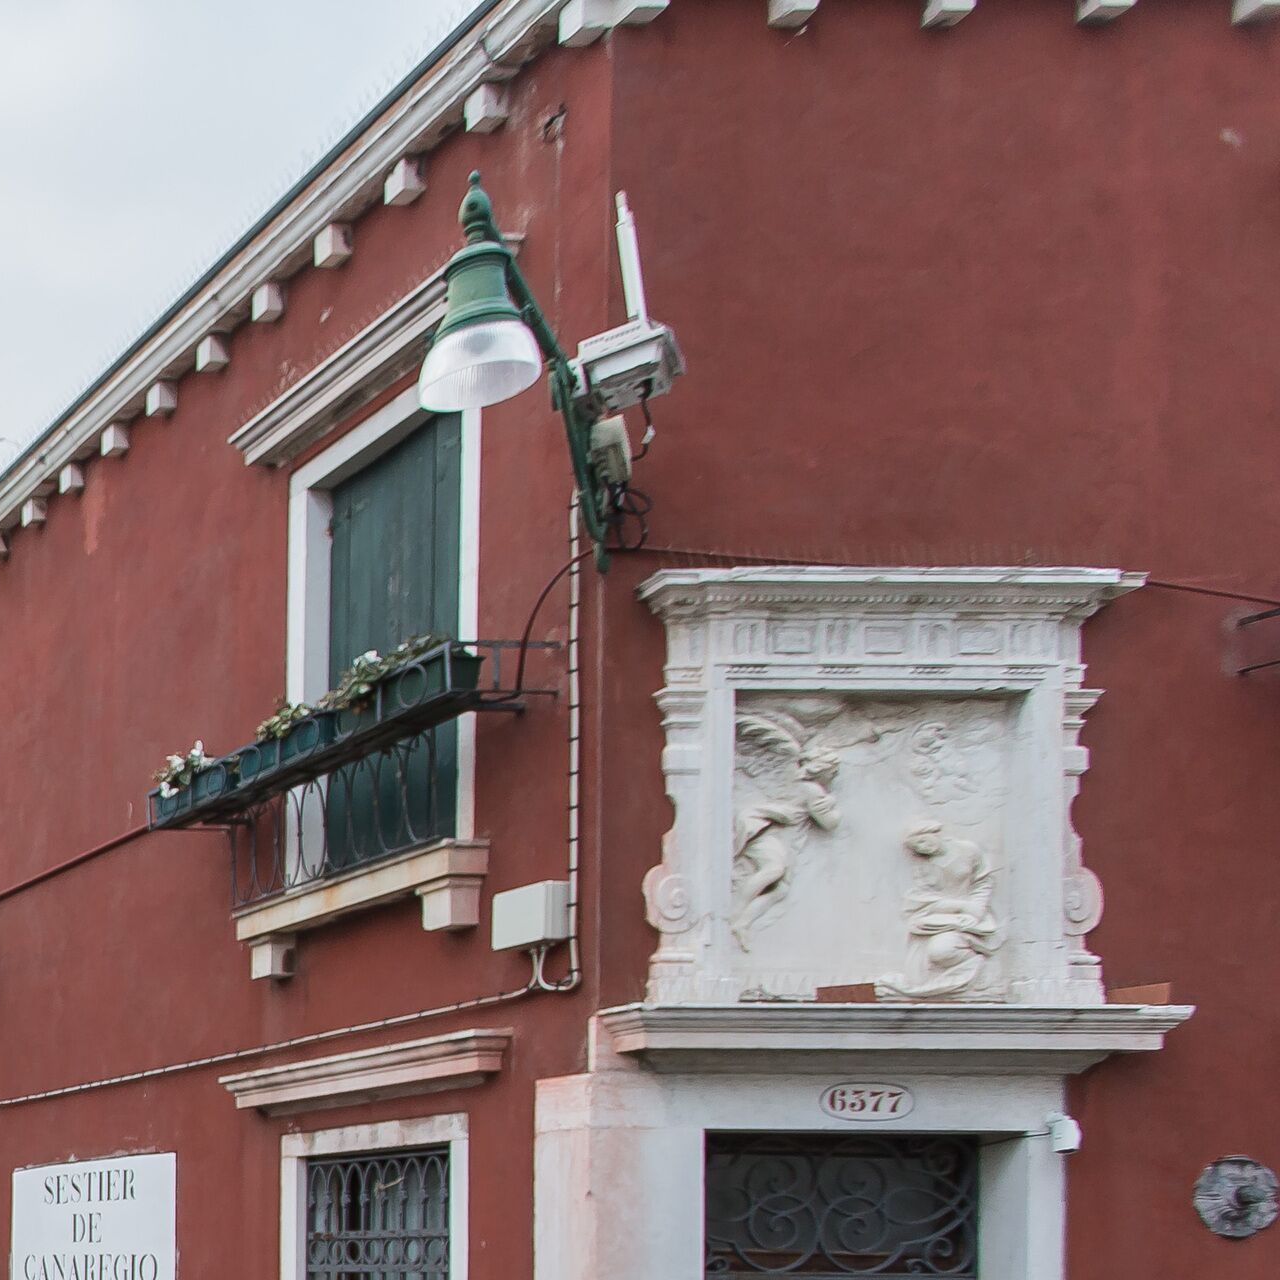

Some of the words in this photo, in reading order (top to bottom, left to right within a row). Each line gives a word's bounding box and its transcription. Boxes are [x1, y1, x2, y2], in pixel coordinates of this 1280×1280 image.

[828, 1088, 905, 1113] 6377
[42, 1168, 137, 1205] SESTIER
[72, 1212, 102, 1243] DE
